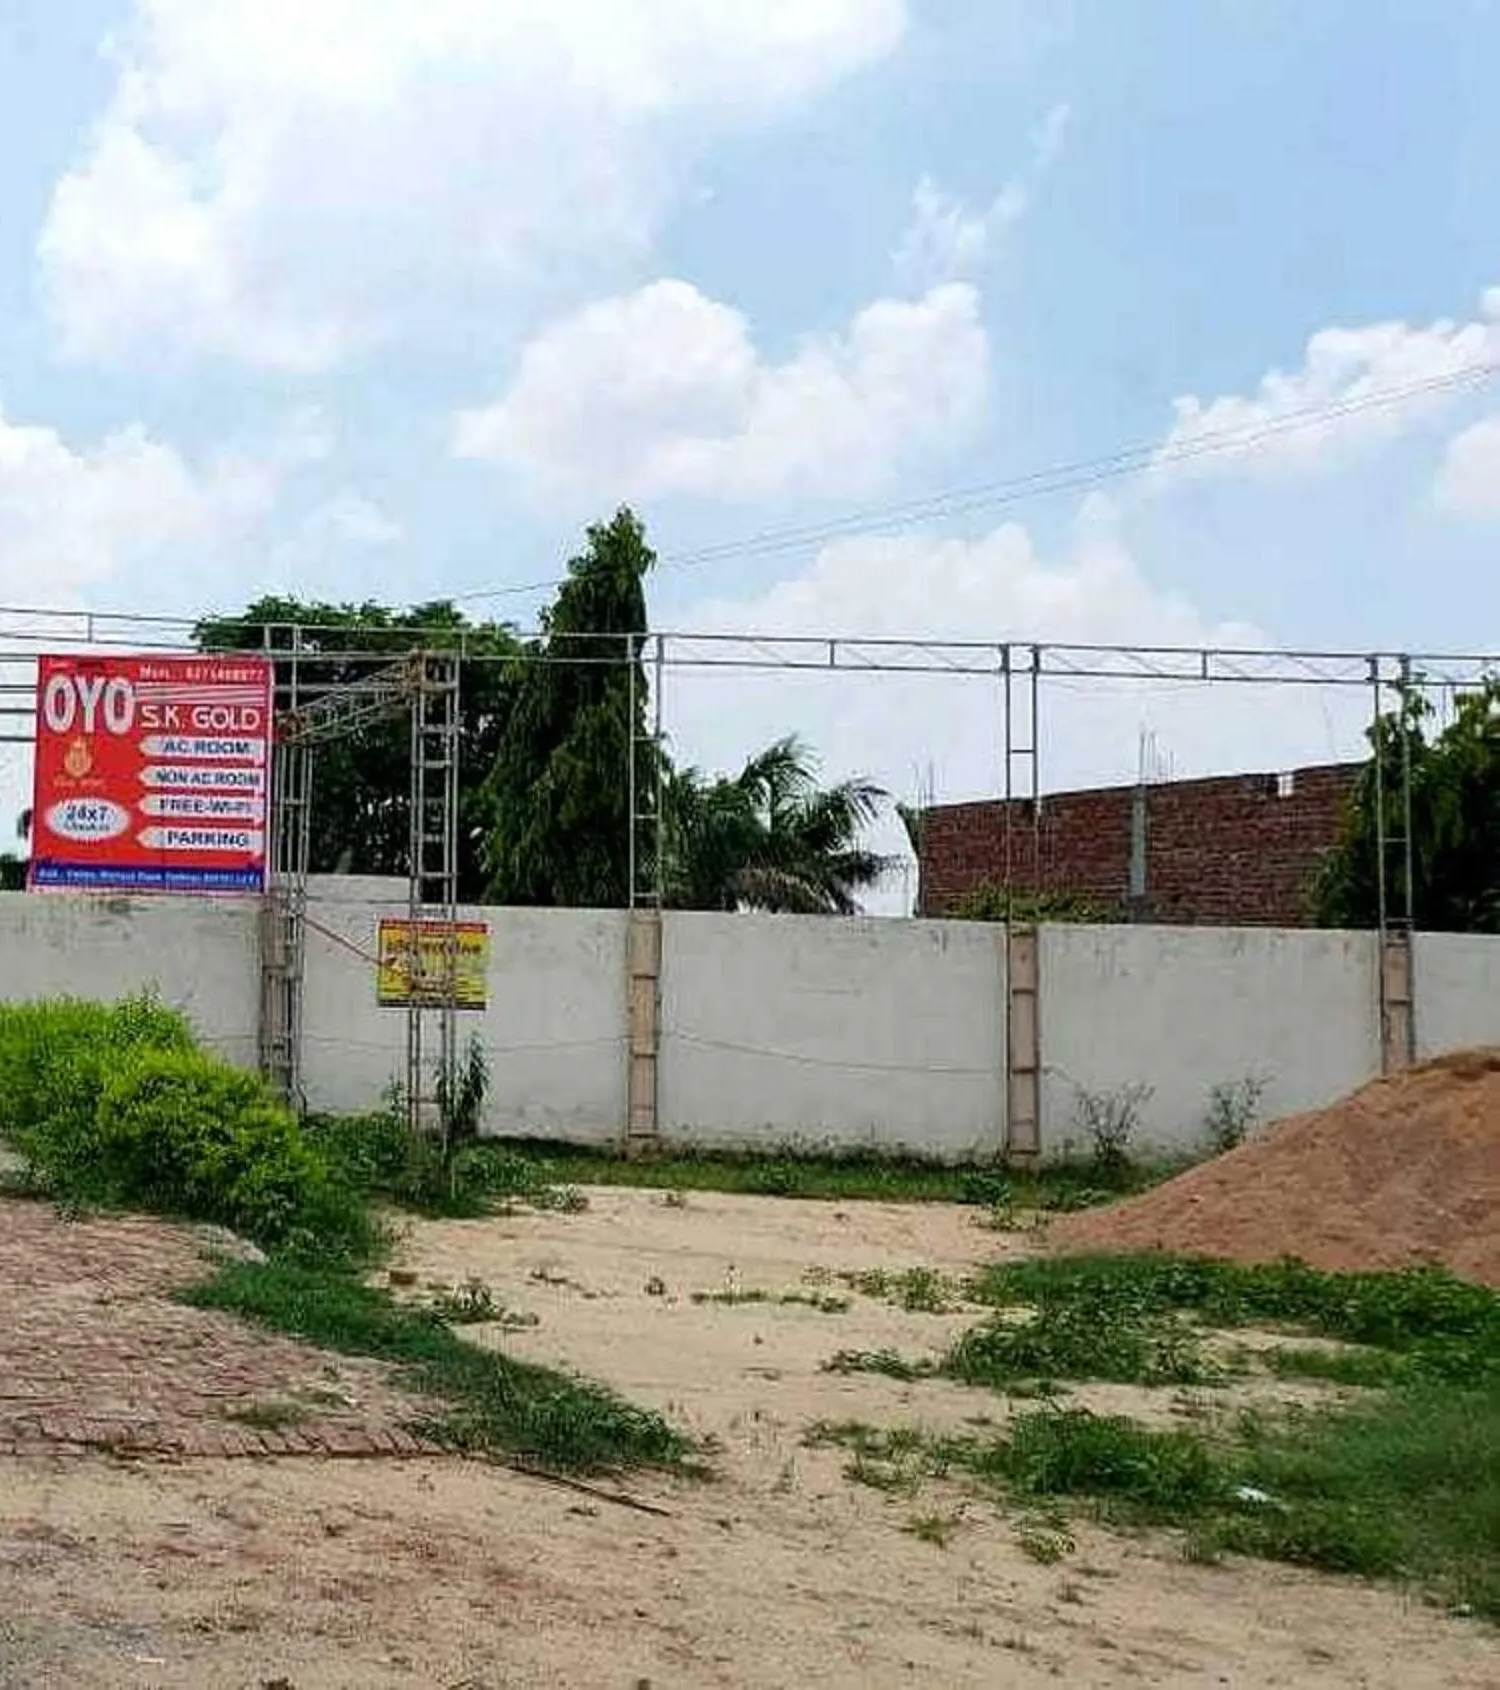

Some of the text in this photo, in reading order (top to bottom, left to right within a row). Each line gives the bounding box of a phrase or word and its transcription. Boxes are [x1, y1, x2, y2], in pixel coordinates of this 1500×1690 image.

[44, 673, 136, 735] OYO
[191, 706, 261, 730] GOLD
[194, 741, 251, 754] ROOM
[166, 831, 250, 847] PARKING
